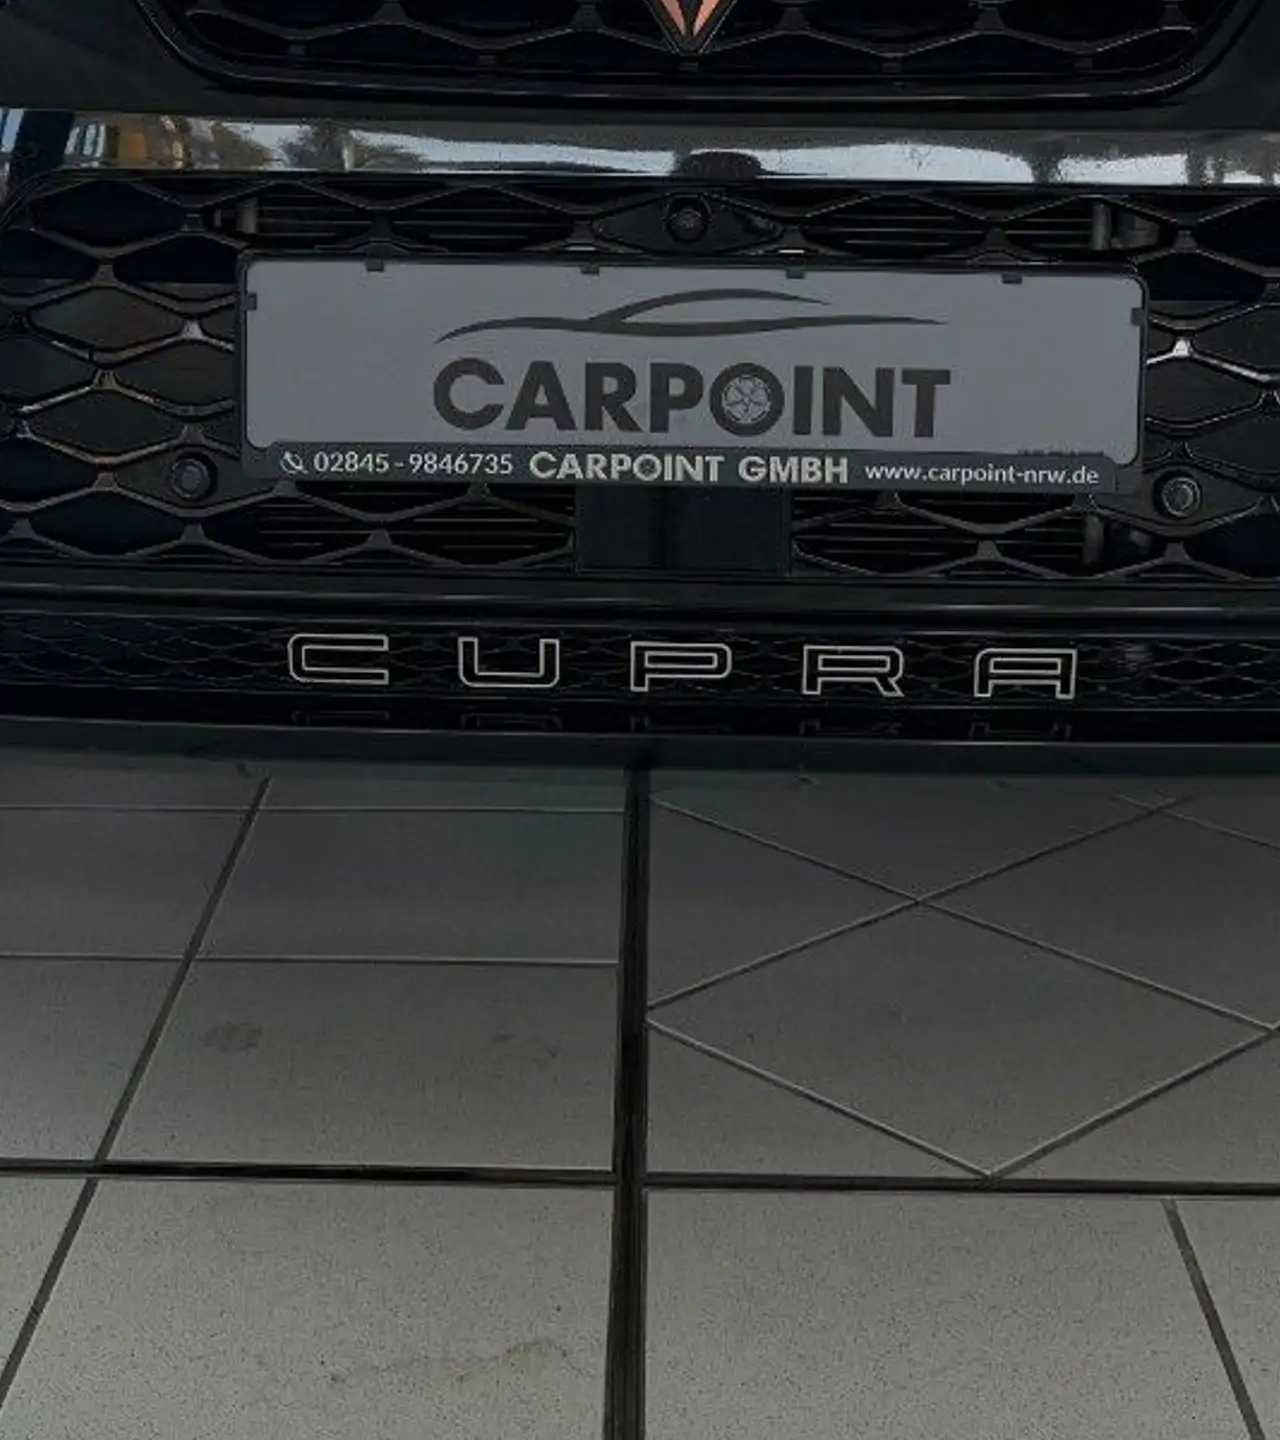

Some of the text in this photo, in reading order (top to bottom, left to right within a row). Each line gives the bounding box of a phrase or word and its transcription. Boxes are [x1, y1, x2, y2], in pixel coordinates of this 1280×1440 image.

[433, 357, 951, 438] CARPOINT
[529, 451, 725, 482] CARPOINT
[738, 456, 848, 483] GMBH
[864, 463, 1100, 487] www.carpoint-nrw.de
[288, 633, 1078, 699] CUPRA
